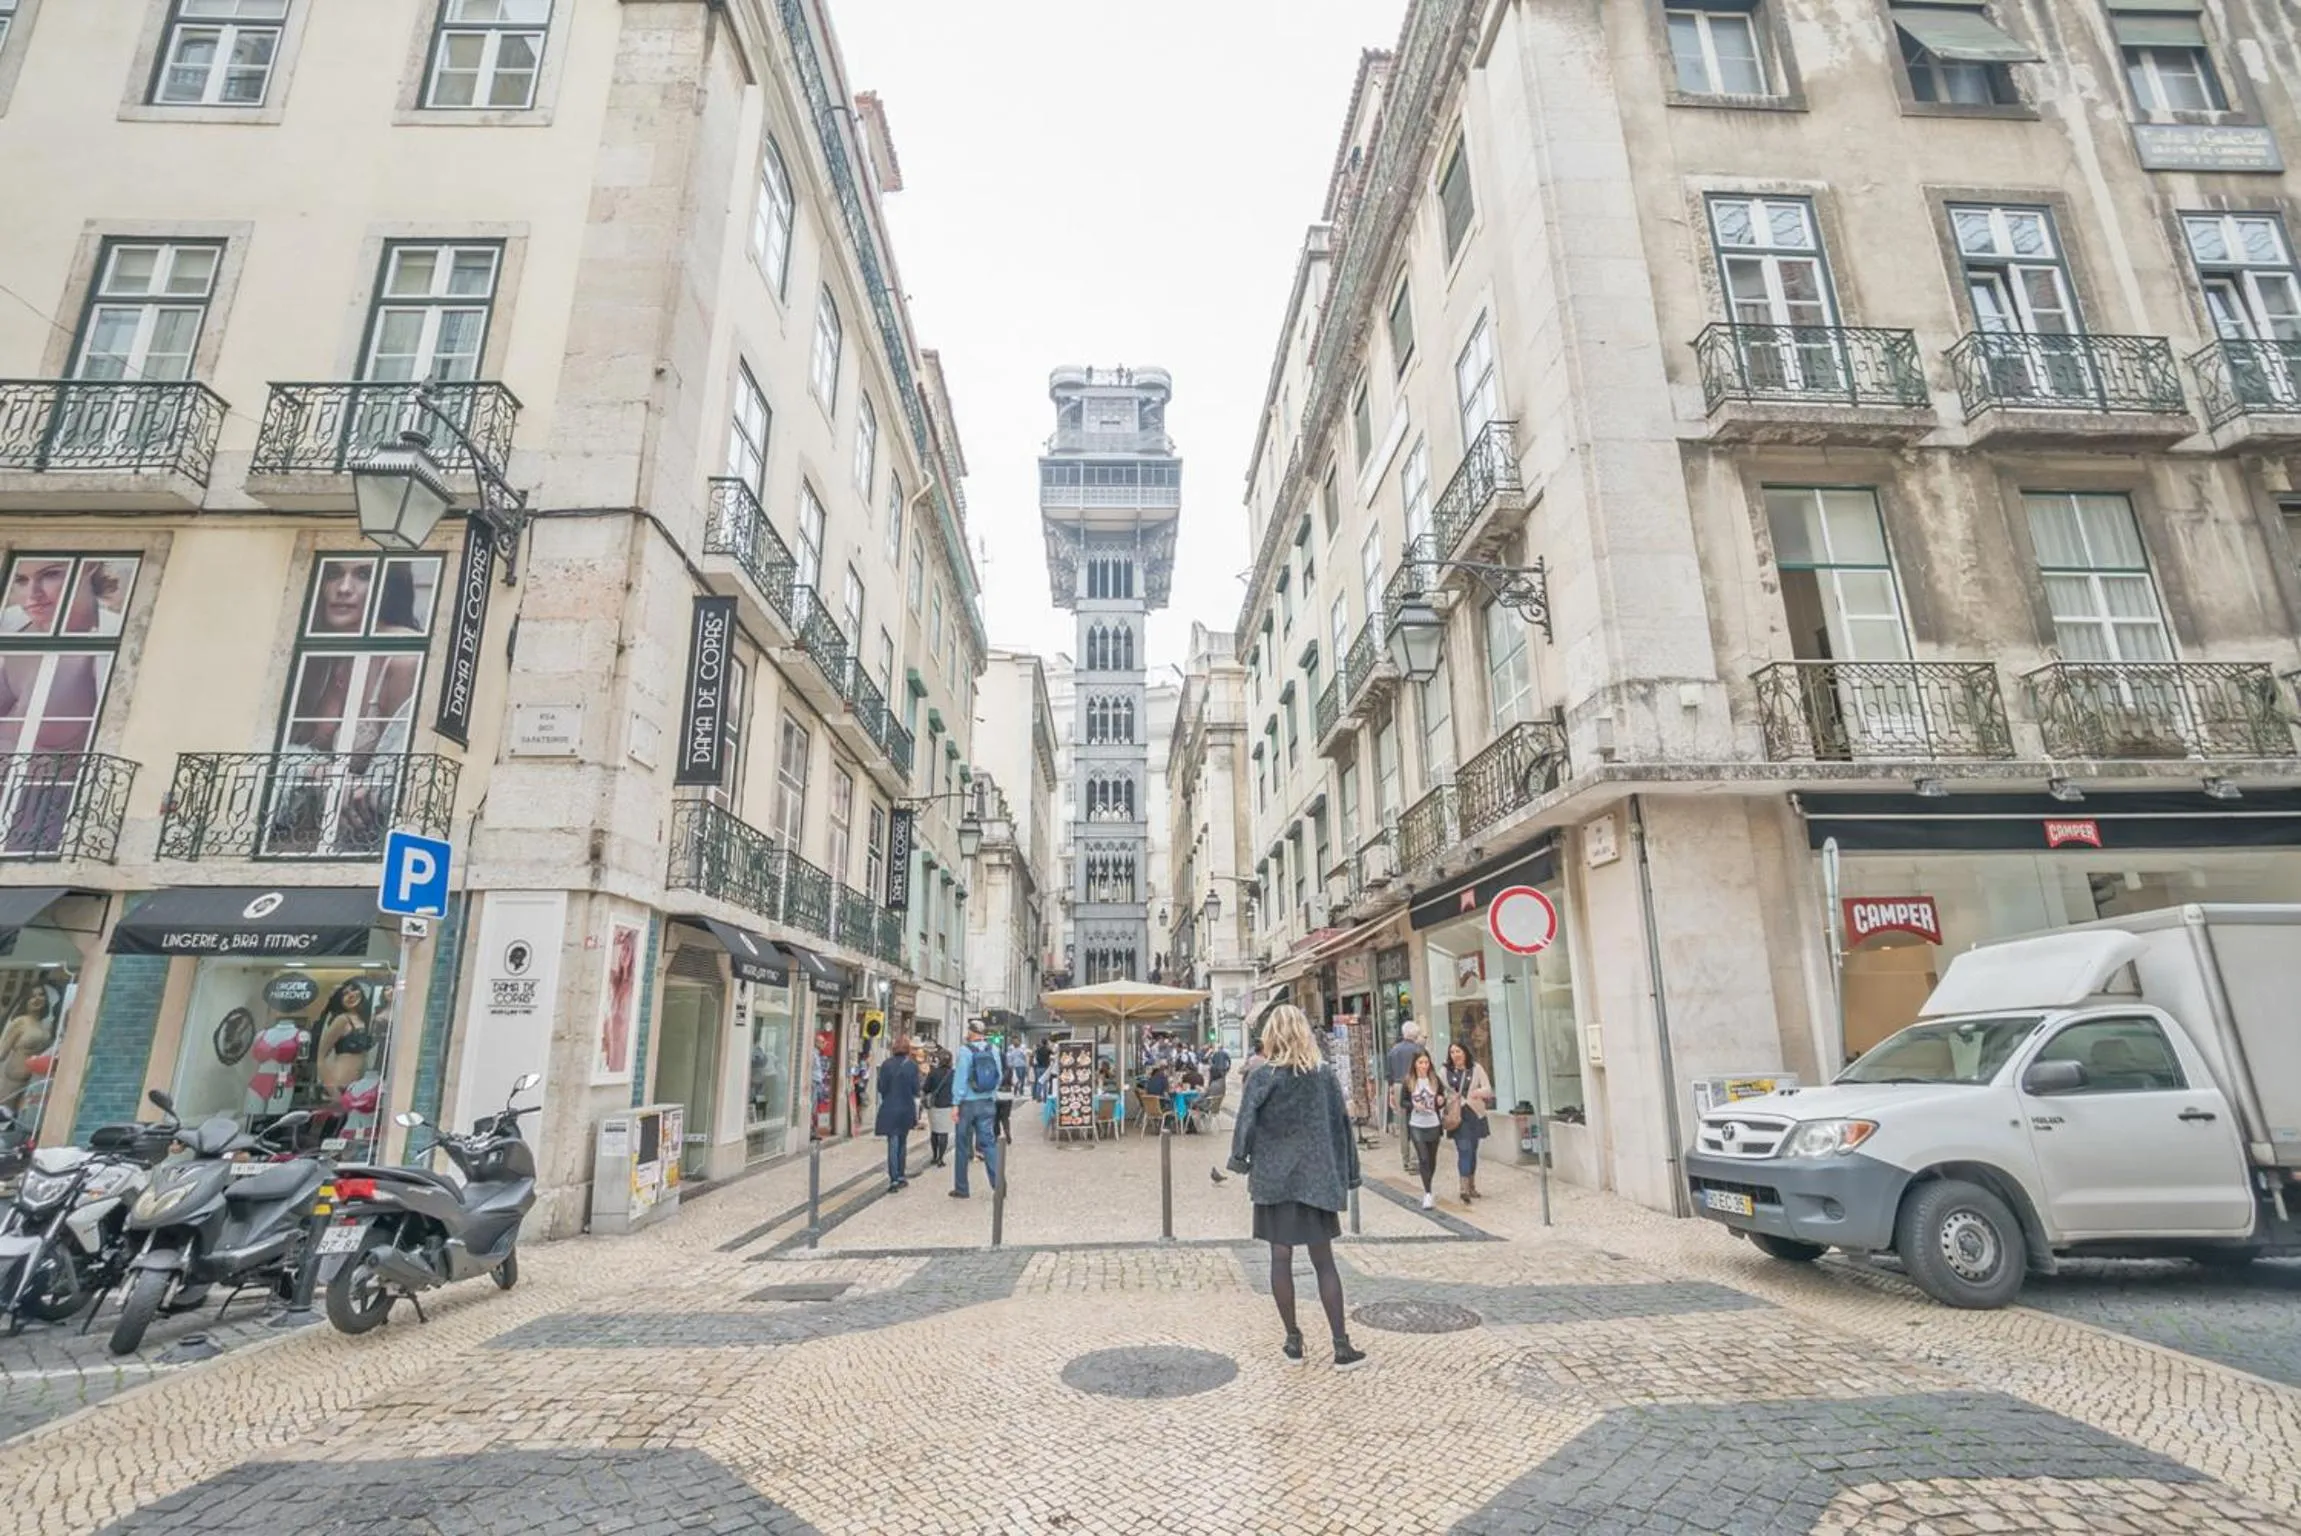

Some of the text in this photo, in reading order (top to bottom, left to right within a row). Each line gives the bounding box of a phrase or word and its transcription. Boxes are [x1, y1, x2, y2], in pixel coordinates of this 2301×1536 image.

[450, 661, 471, 716] DAMA
[461, 623, 478, 653] DE
[697, 687, 717, 709] DE
[692, 715, 713, 763] DAMA
[2047, 822, 2097, 841] CAMPER
[398, 846, 437, 901] P
[1853, 902, 1937, 934] CAMPER
[161, 933, 219, 948] LINGERIE
[232, 934, 259, 948] BRA
[493, 982, 519, 993] DAMA
